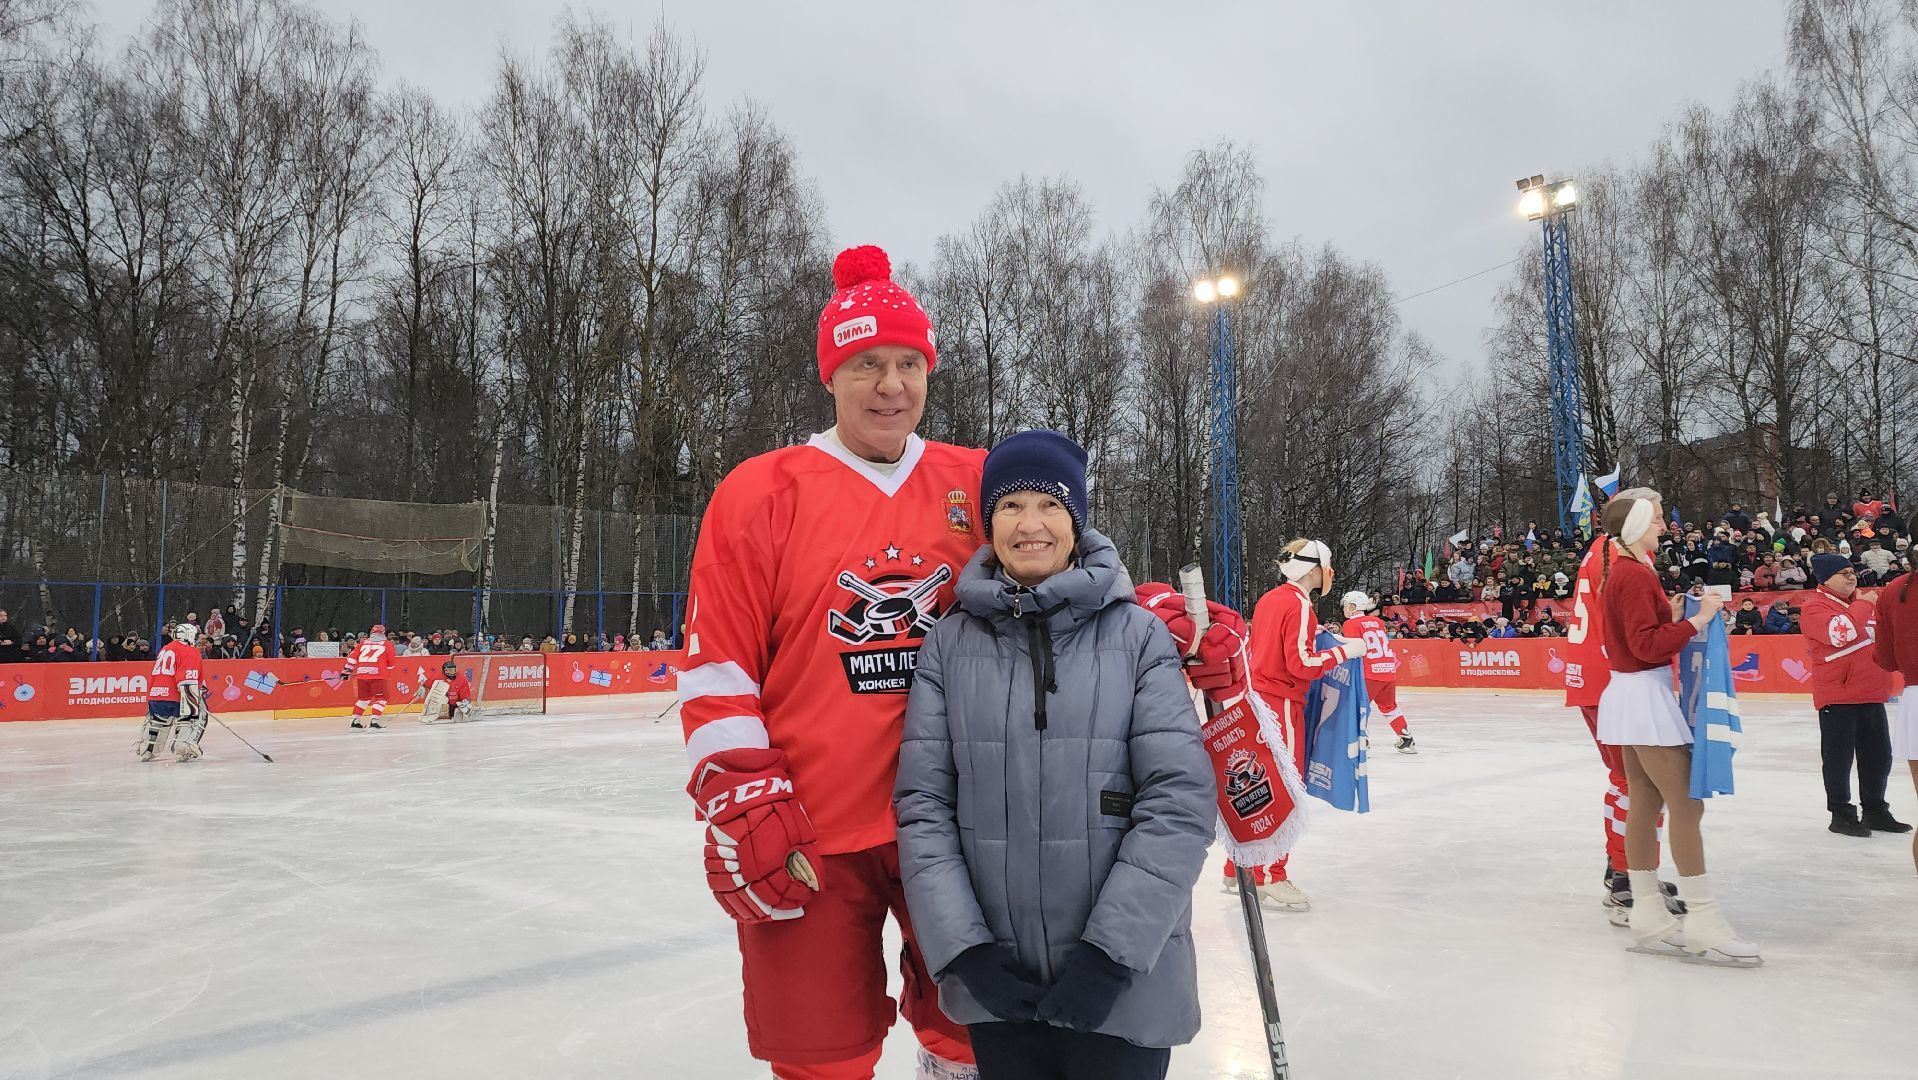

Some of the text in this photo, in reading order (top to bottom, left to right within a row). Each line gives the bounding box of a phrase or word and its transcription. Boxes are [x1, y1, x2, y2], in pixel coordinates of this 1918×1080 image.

[837, 323, 873, 342] ЗИМА
[151, 649, 176, 676] 20
[358, 644, 386, 663] 27
[1459, 650, 1521, 667] ЗИМА
[498, 664, 550, 681] ЗИМА
[849, 652, 896, 675] МАТЧ
[1466, 669, 1521, 677] ПОДМОСКОВЬЕ
[185, 669, 199, 680] 20
[857, 677, 906, 691] ХОККЕЯ
[68, 675, 148, 695] ЗИМА
[68, 695, 147, 706] В ПОДМОСКОВЬЕ
[1212, 726, 1246, 753] ОБЛАСТЬ
[707, 777, 794, 819] CCM
[1250, 814, 1272, 835] 2024
